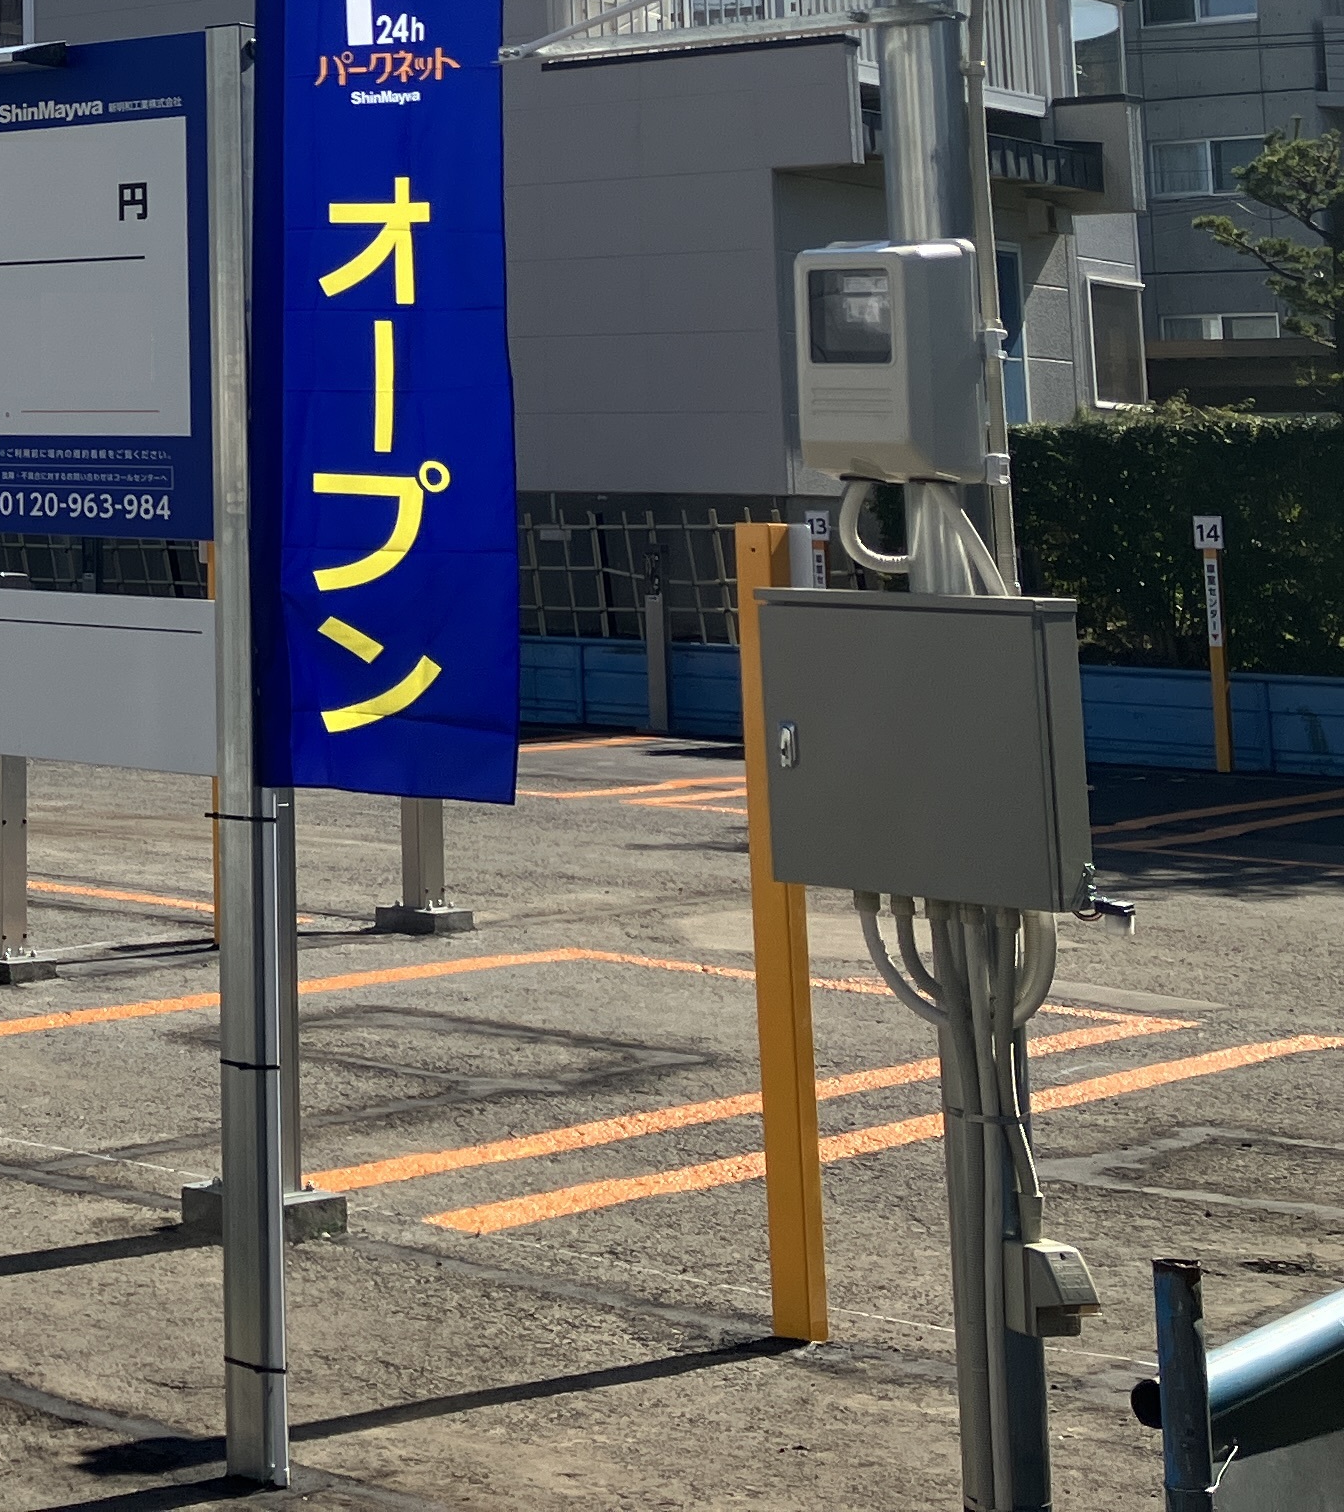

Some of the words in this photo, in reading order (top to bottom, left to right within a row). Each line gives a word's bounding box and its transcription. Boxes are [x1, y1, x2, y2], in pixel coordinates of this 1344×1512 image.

[376, 13, 425, 45] 24h
[314, 46, 461, 86] パークネット
[350, 90, 421, 105] ShinMaywa
[118, 182, 148, 221] 円
[313, 176, 449, 733] オープン
[0, 491, 171, 520] 0120-963-984
[808, 519, 827, 535] 13
[1196, 524, 1220, 542] 14
